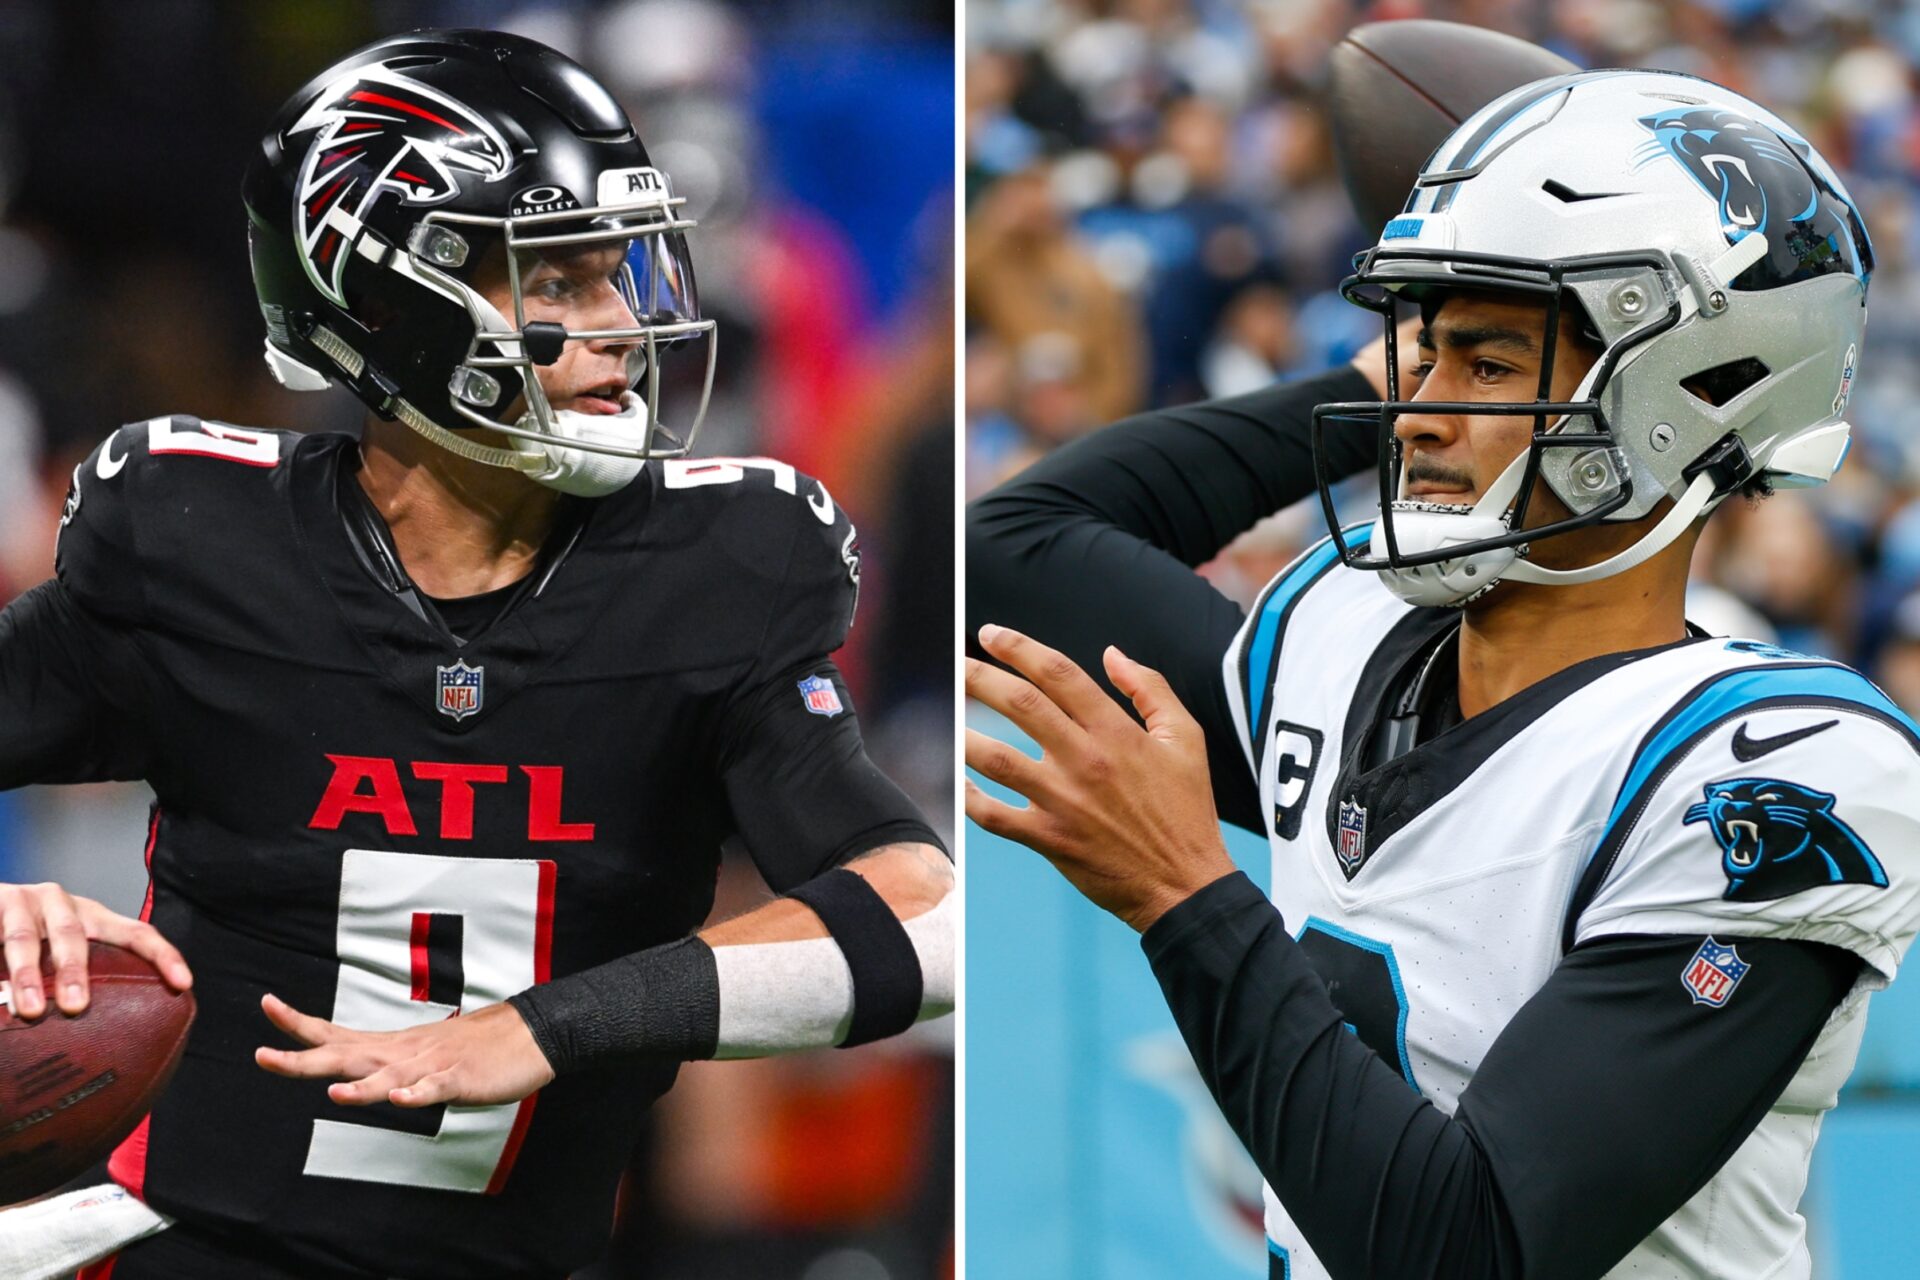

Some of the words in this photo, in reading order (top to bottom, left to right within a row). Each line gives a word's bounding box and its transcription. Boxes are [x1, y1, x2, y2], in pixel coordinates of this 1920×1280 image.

[626, 171, 662, 193] ATL
[512, 200, 574, 216] OAKLEY
[444, 687, 476, 710] NFL
[1275, 727, 1314, 809] C
[308, 754, 596, 841] ATL
[1341, 829, 1360, 857] NFL
[1687, 958, 1729, 1001] NFL
[303, 849, 557, 1194] 9
